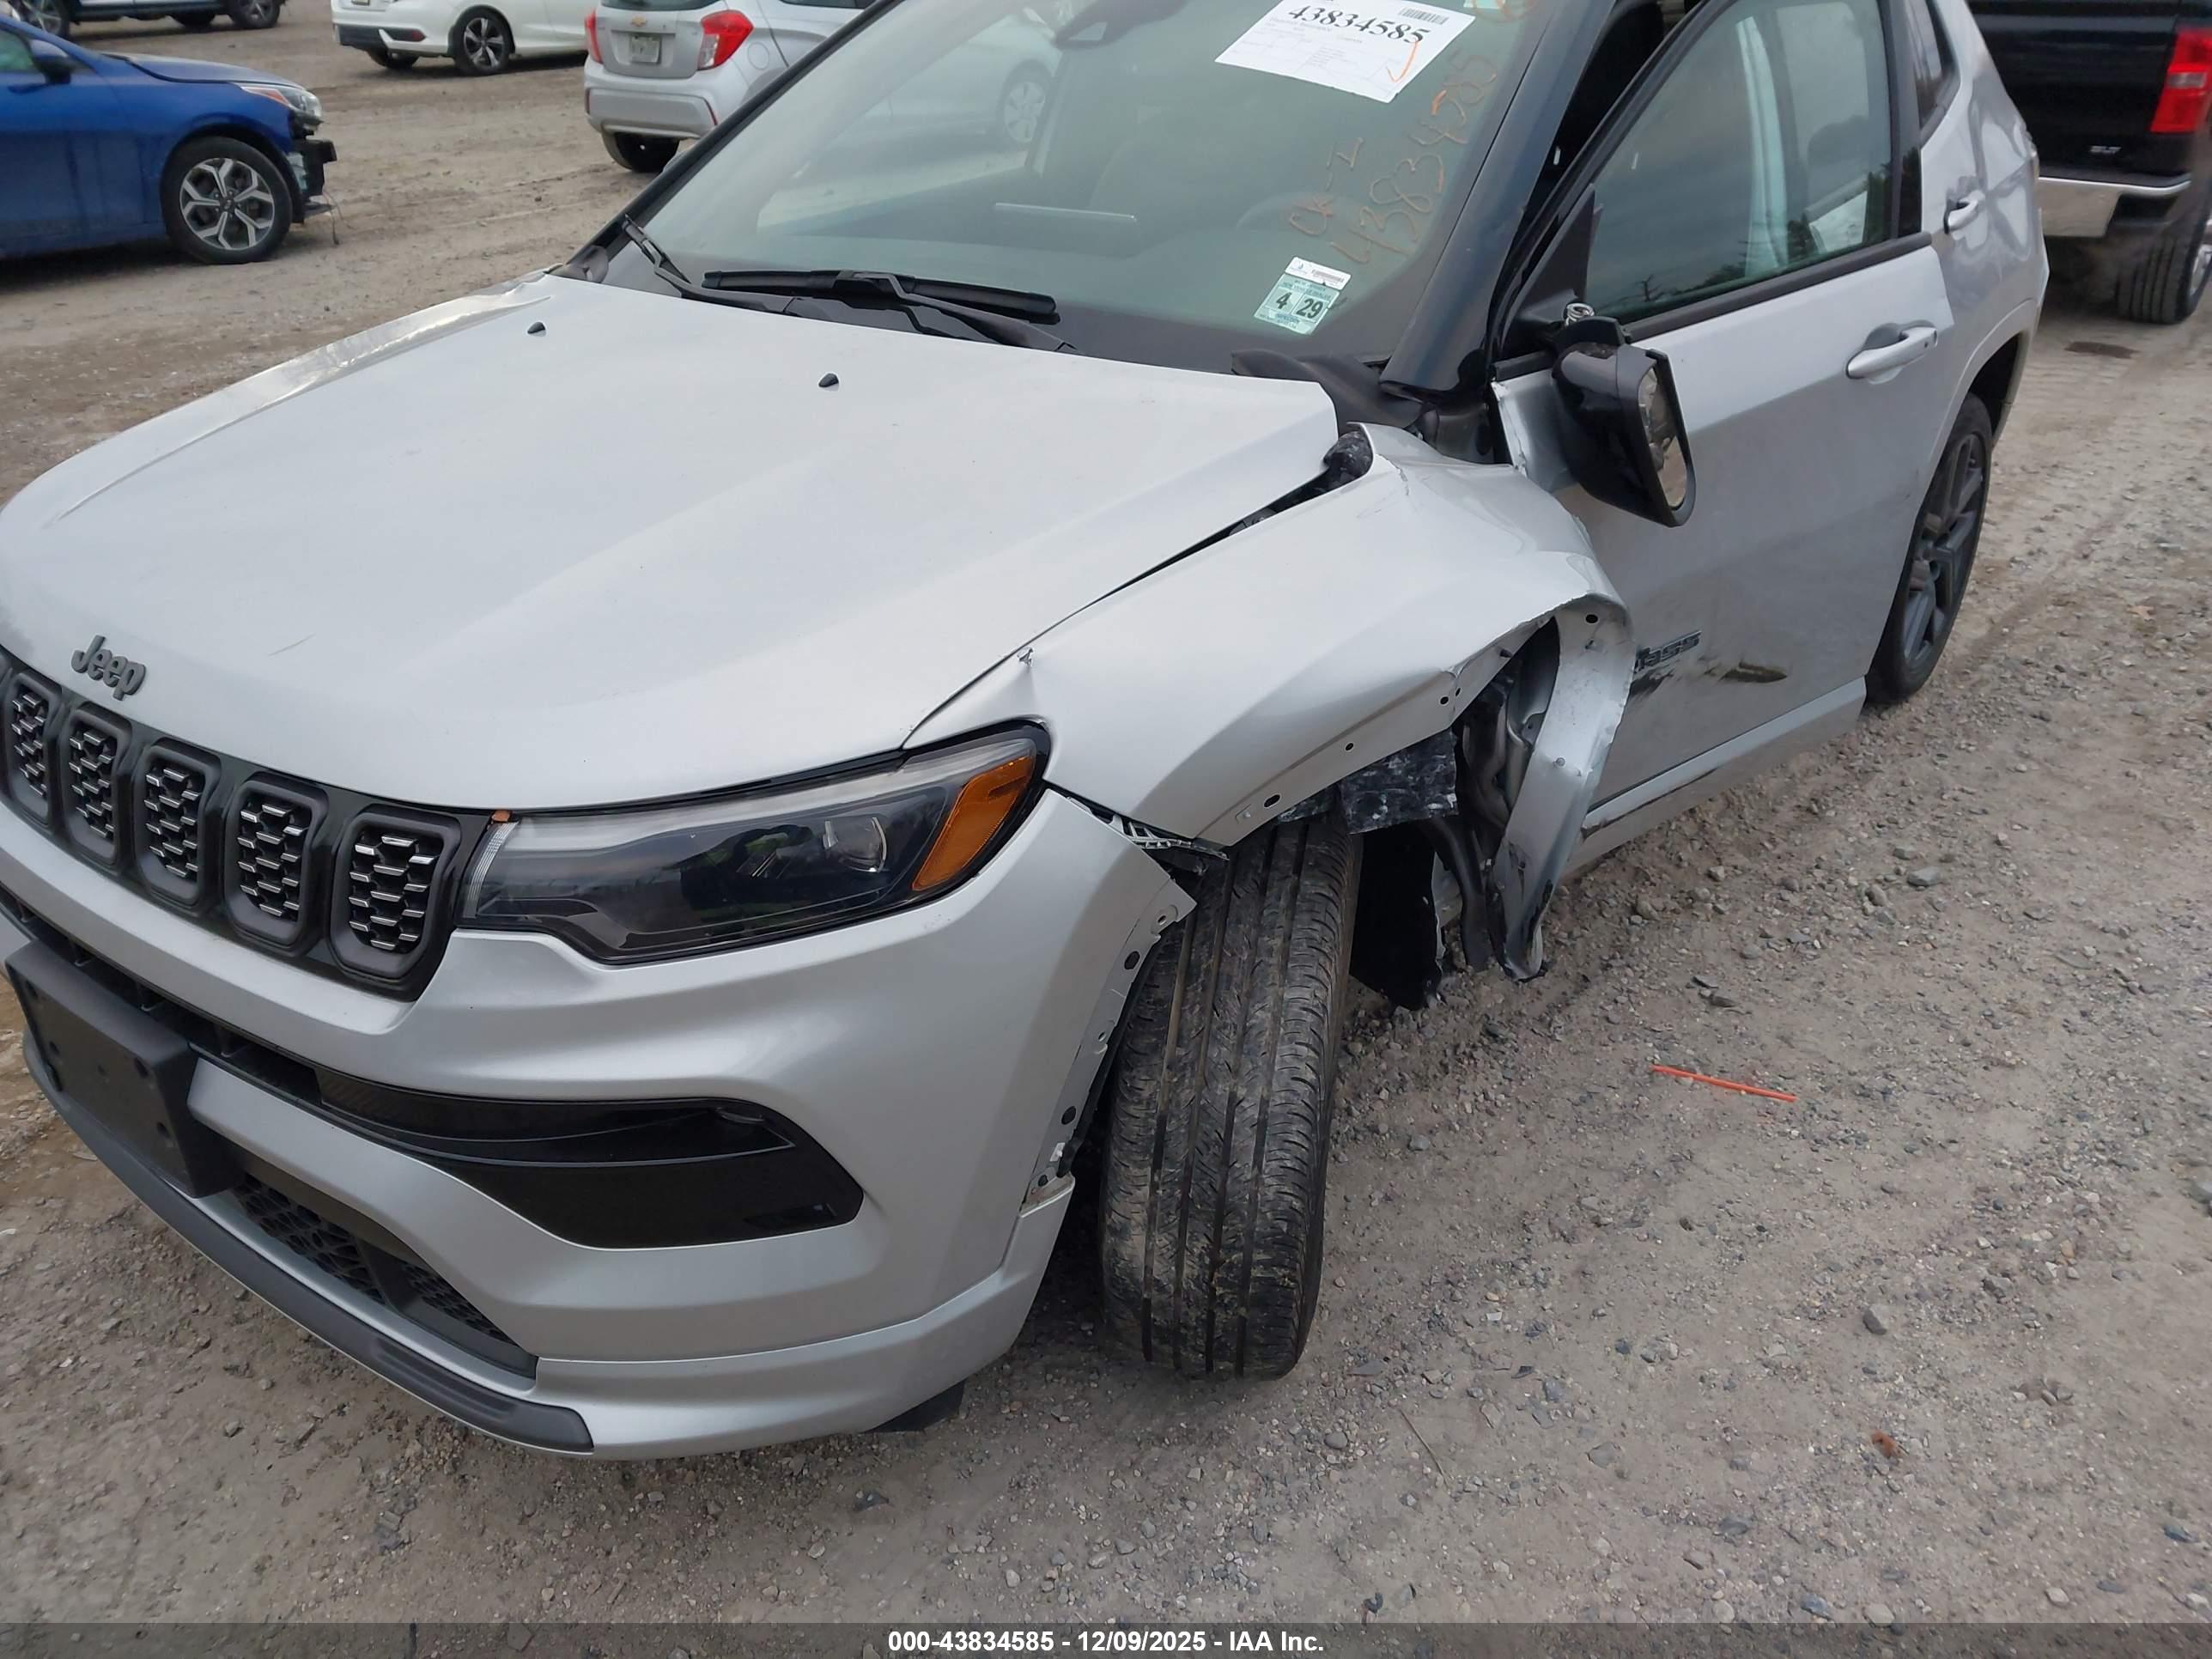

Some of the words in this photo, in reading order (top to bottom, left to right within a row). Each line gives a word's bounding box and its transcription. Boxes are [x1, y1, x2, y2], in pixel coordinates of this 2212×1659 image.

[1288, 5, 1431, 44] 43834585
[1276, 291, 1292, 310] 4
[1296, 297, 1324, 319] 29
[71, 635, 146, 701] Jeep
